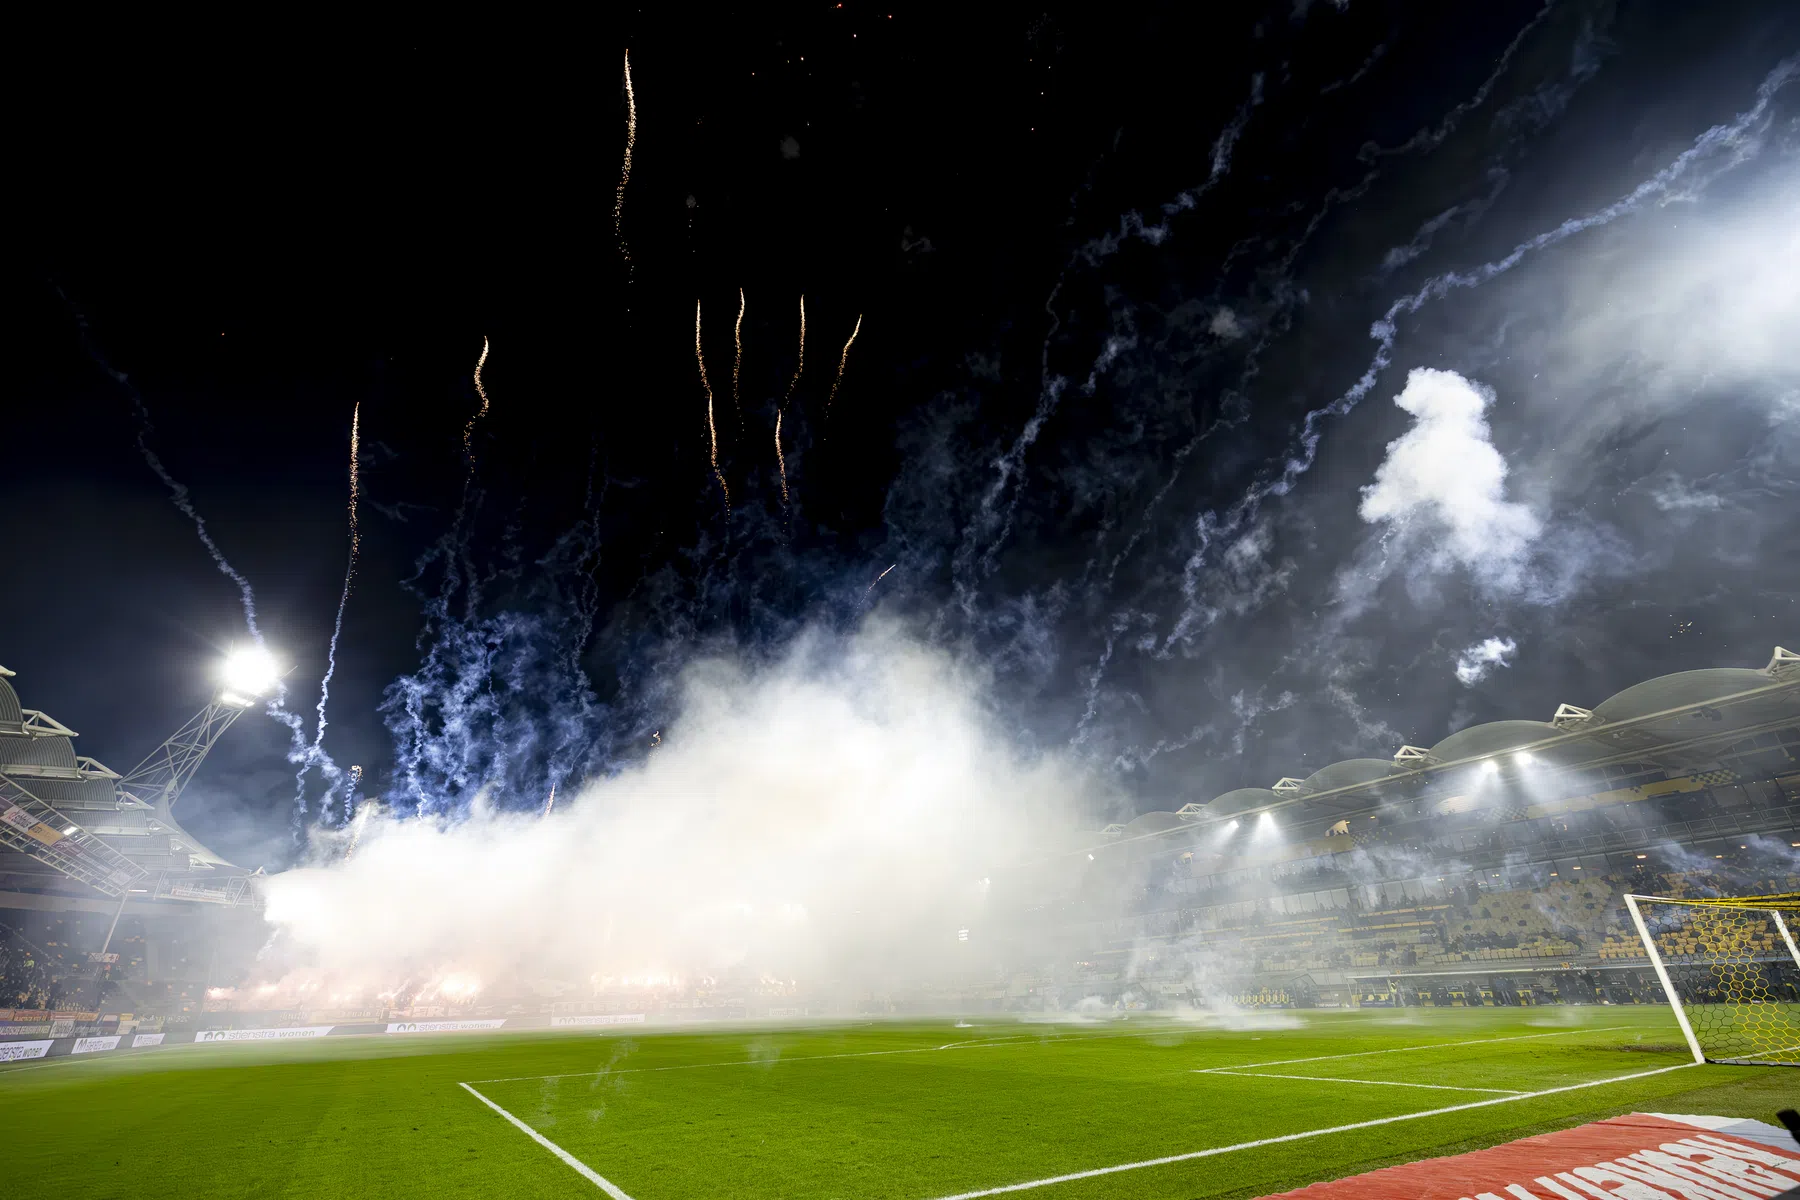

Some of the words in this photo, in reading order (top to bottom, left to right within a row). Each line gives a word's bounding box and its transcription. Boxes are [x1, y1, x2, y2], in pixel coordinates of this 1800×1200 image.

[420, 1022, 459, 1032] stienstra
[228, 1030, 276, 1041] stienstra
[279, 1030, 315, 1038] wonen
